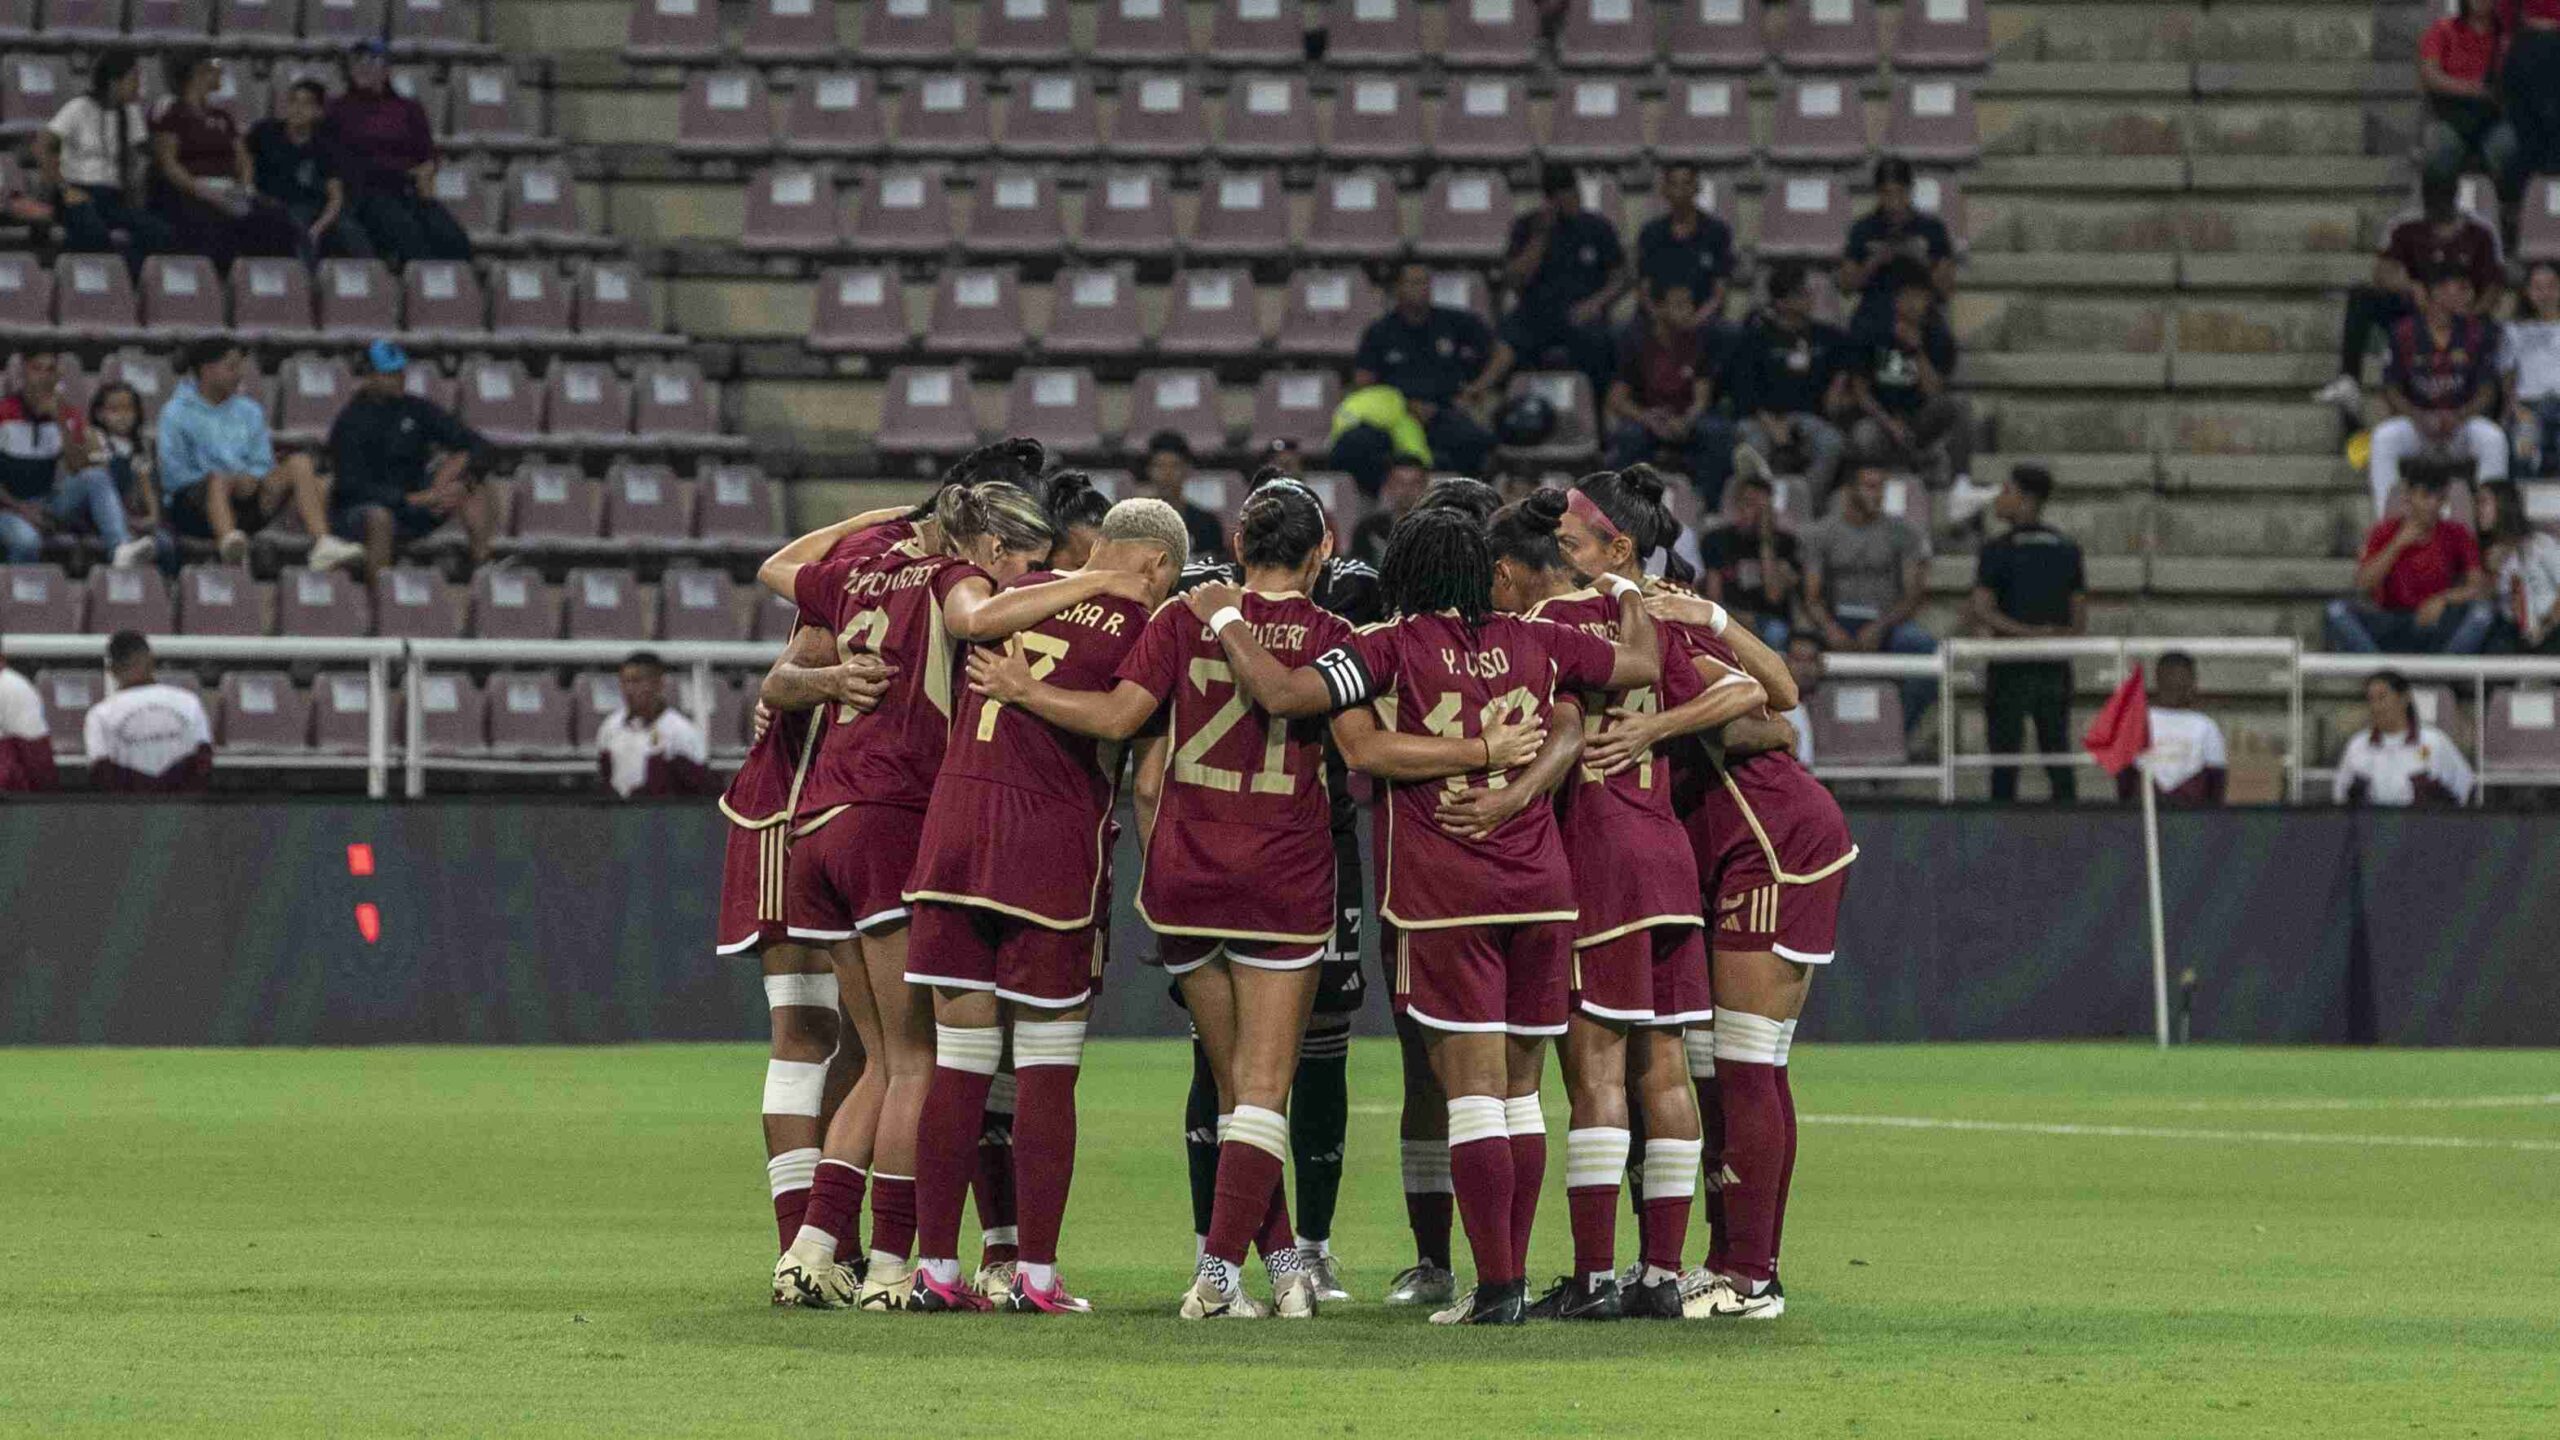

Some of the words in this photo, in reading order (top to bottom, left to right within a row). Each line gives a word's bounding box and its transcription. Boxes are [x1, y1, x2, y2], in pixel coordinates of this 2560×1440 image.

[1102, 613, 1125, 637] R.
[1316, 647, 1346, 667] C
[1441, 648, 1461, 675] Y.
[1175, 656, 1296, 795] 21
